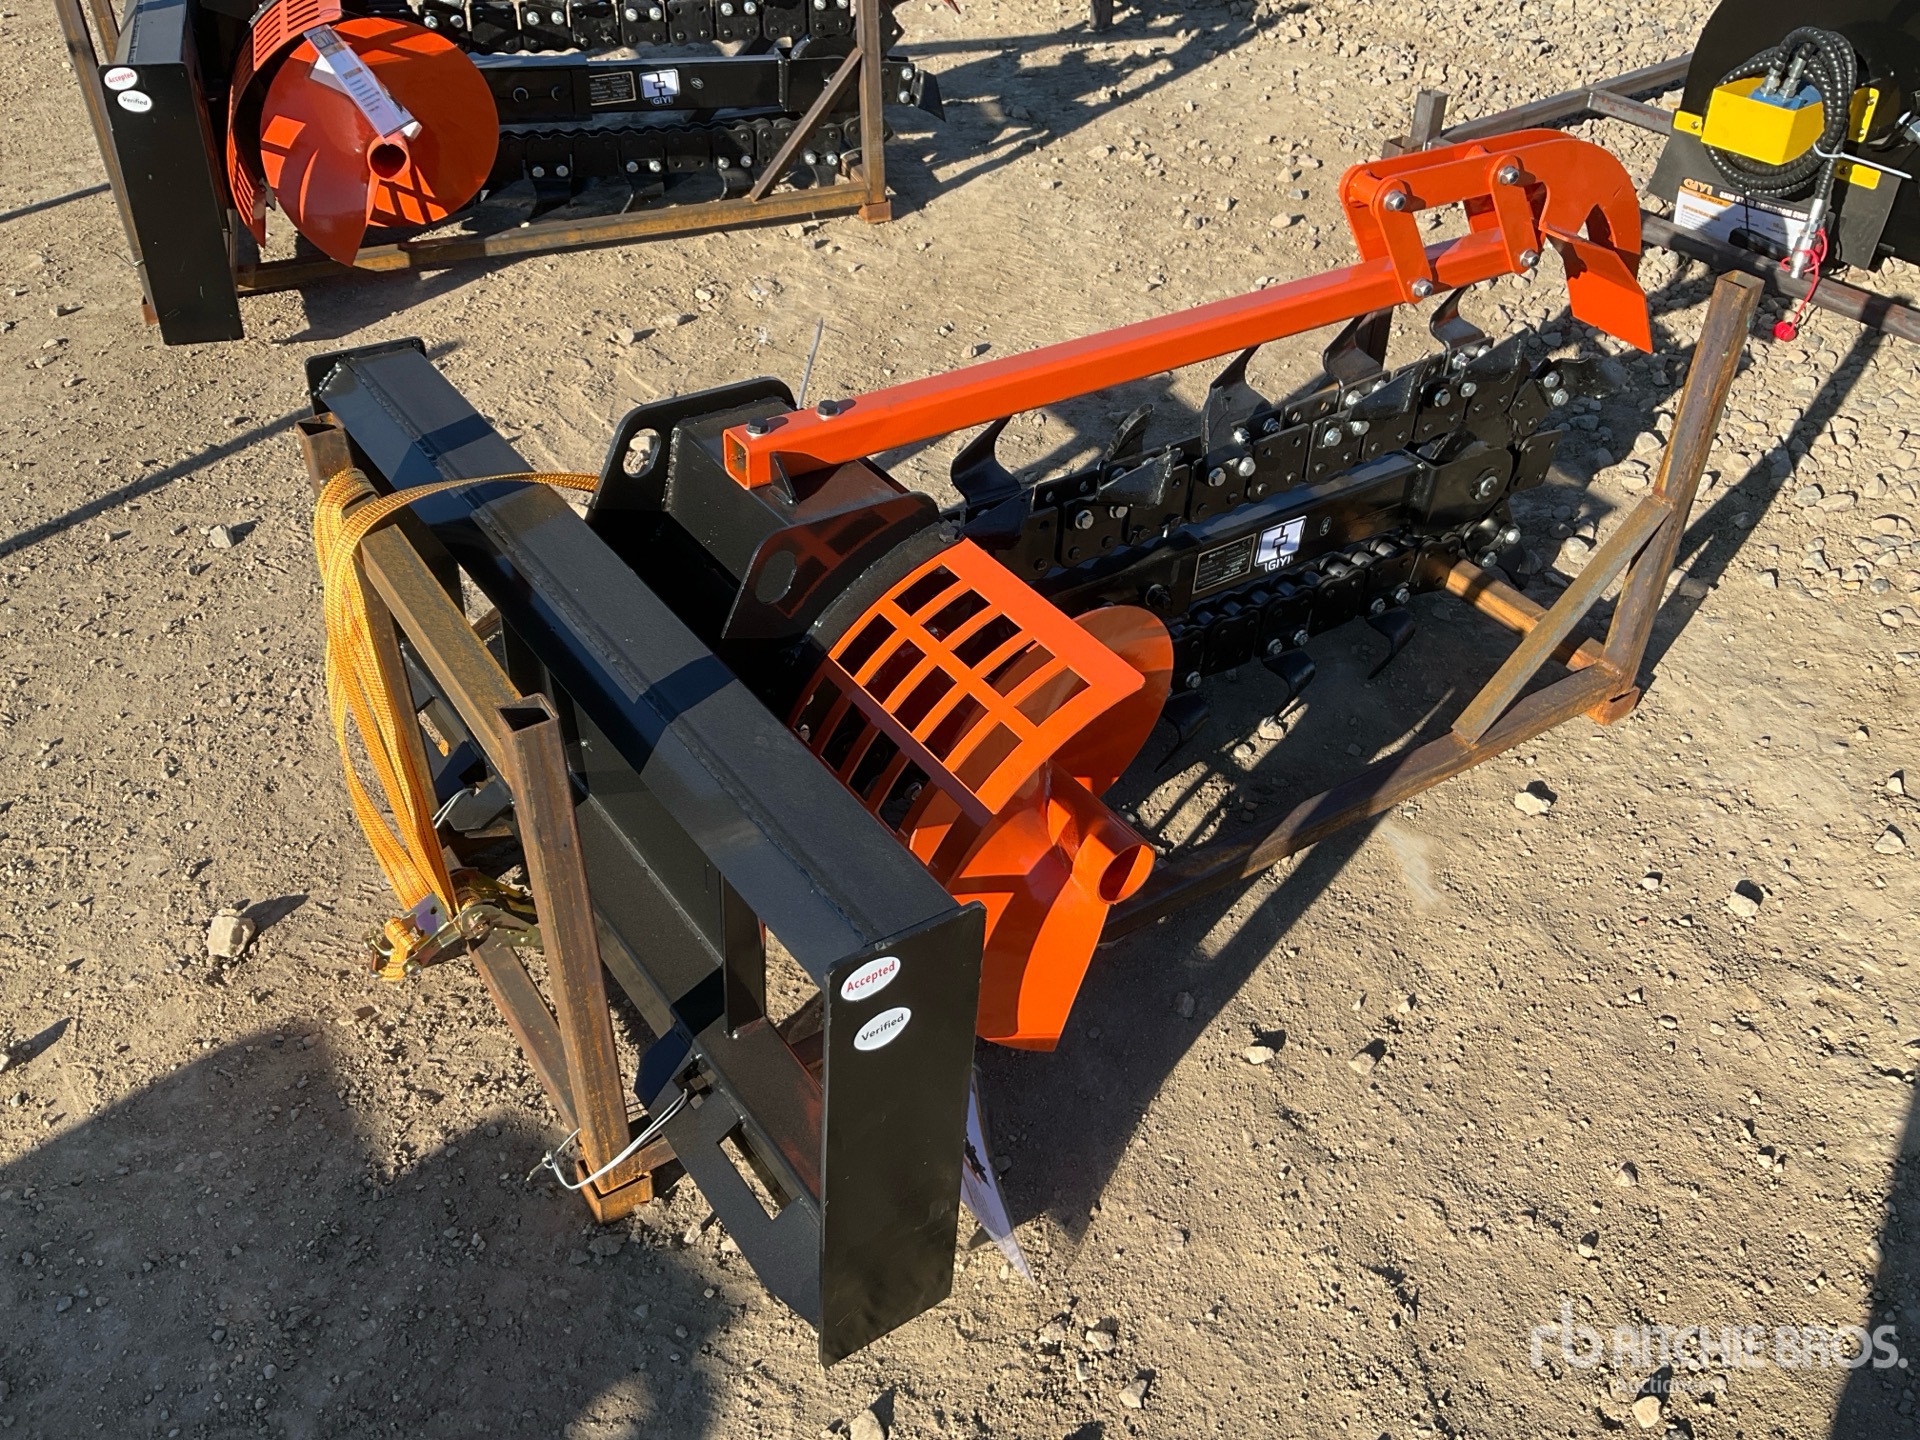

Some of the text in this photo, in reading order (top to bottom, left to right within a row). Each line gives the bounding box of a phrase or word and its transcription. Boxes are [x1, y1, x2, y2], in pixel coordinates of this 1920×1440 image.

[108, 72, 133, 83] Accepted
[122, 96, 147, 105] Verified
[652, 96, 671, 105] GIYI
[1683, 178, 1713, 195] GIYI
[1735, 196, 1755, 206] STER
[1268, 557, 1290, 571] GIYI
[846, 960, 895, 993] Accepted
[861, 1013, 904, 1041] Verified
